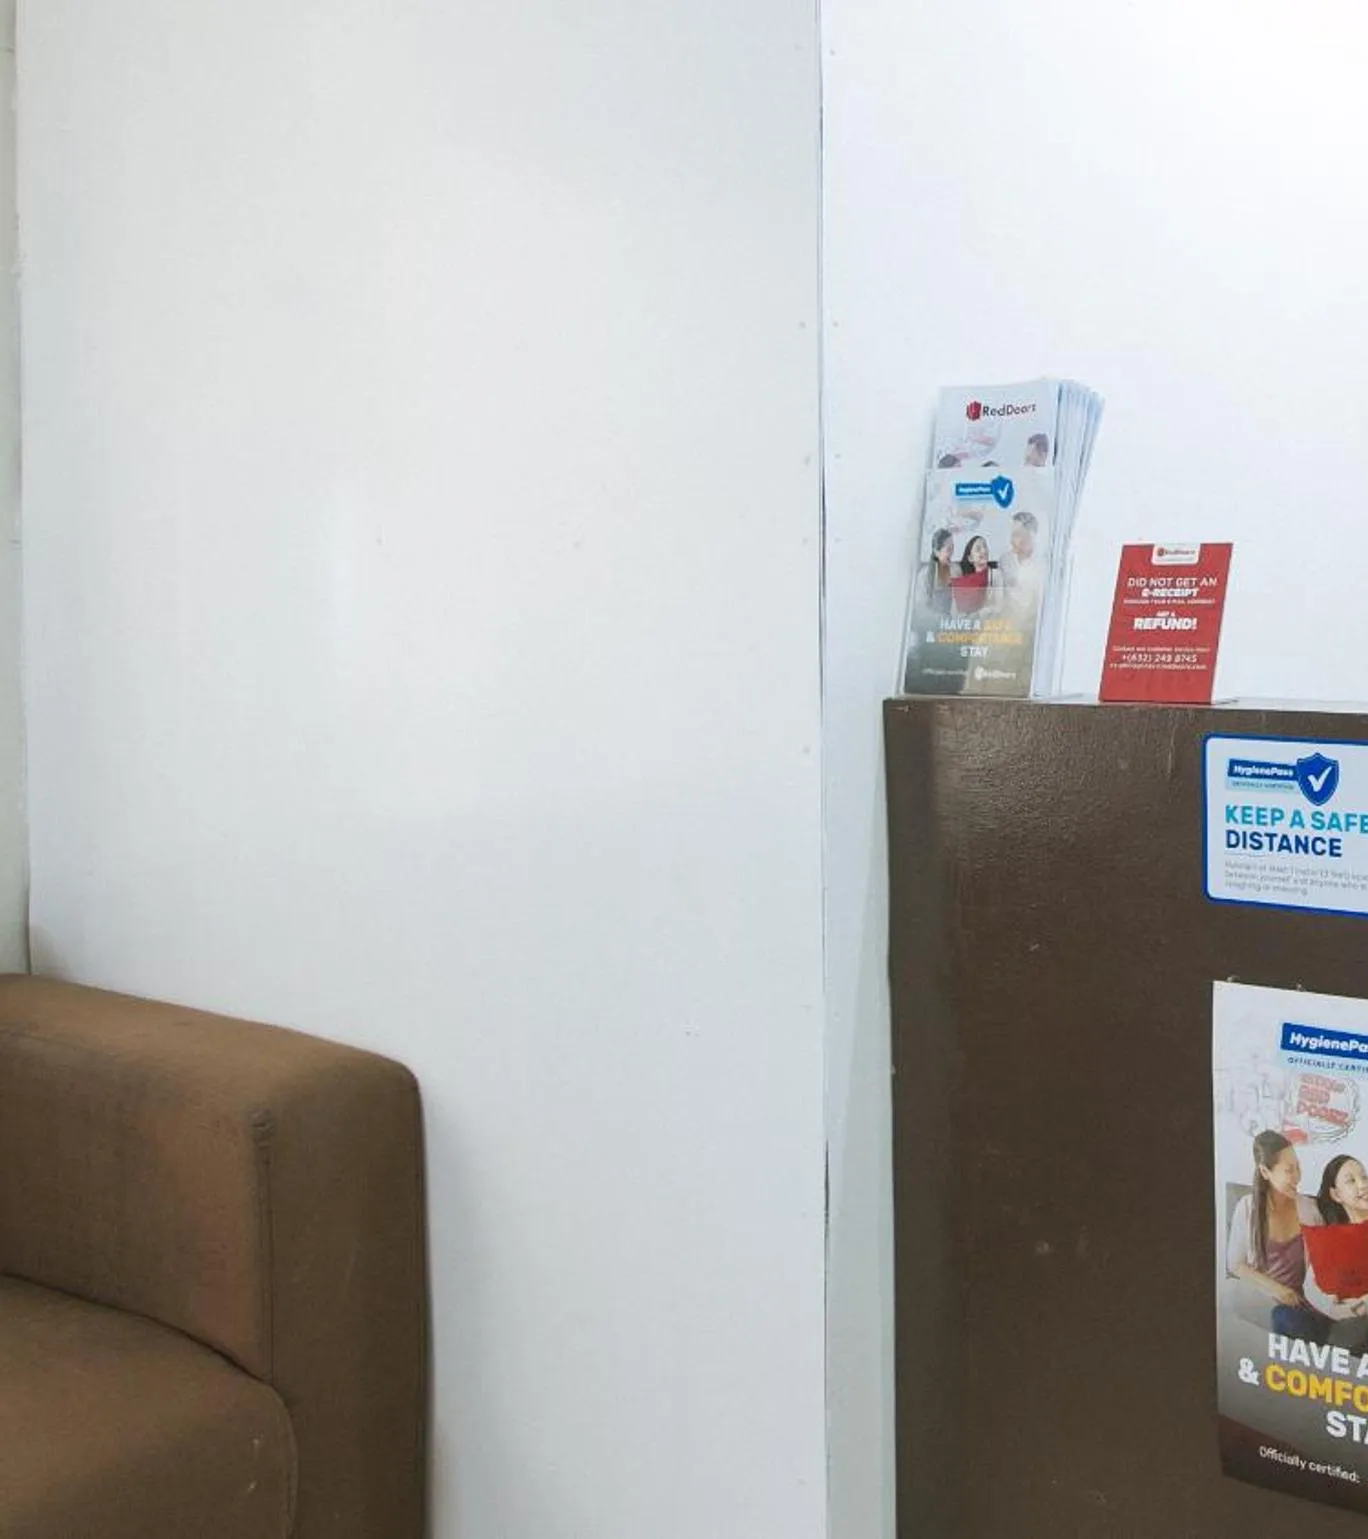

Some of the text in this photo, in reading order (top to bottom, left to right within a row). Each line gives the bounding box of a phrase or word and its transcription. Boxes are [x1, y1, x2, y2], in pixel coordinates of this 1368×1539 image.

[1127, 577, 1218, 587] DID NOT GET AN
[1134, 617, 1198, 630] REFUND!
[960, 646, 989, 658] STAY
[1225, 804, 1285, 827] KEEP
[1289, 810, 1305, 829] A
[1225, 829, 1343, 858] DISTANCE
[1268, 1333, 1351, 1375] HAVE
[1238, 1357, 1259, 1386] &
[1258, 1445, 1361, 1485] Officially certified:
